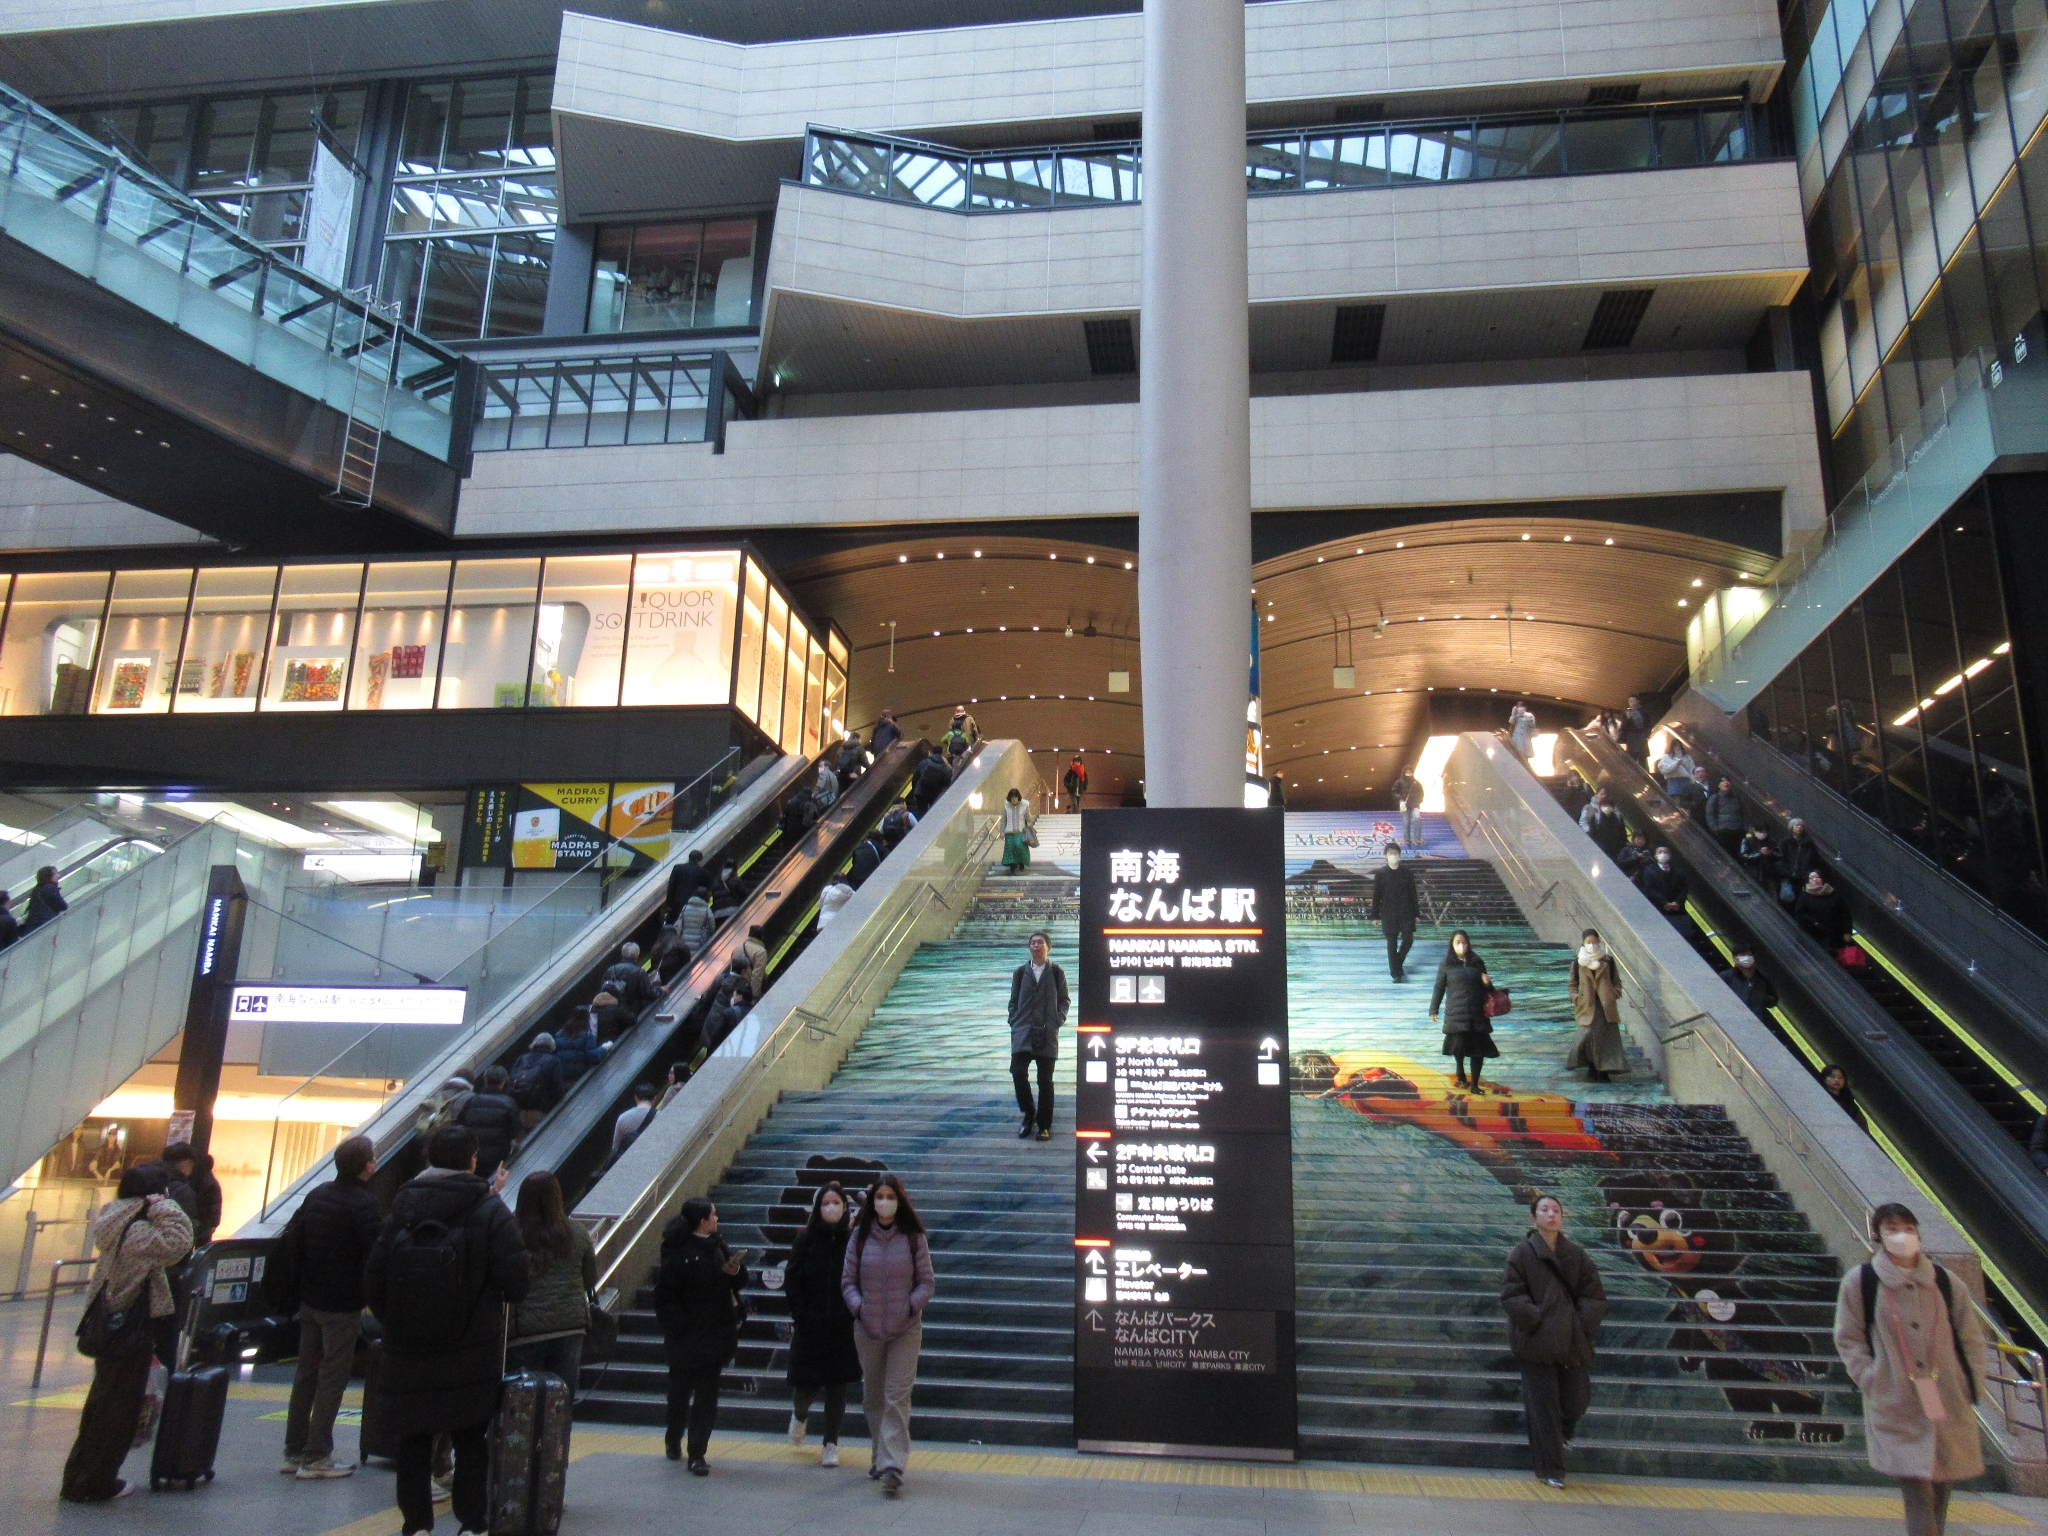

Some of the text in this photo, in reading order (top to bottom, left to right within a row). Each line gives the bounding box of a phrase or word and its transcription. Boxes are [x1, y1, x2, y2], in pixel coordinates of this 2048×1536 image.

[557, 787, 606, 796] MADRAS
[561, 796, 601, 805] CURRY
[551, 841, 600, 849] MADRAS
[557, 850, 592, 858] STAND
[1109, 848, 1180, 884] 南海
[1108, 887, 1257, 923] なんば駅
[202, 898, 222, 975] NANKAI NAMBA
[1109, 939, 1260, 953] NANKAI NAMBA STN.
[1115, 1057, 1179, 1067] 3F North Gate
[1115, 1143, 1215, 1163] 2F中央改札口
[1116, 1164, 1187, 1175] 2F Central Gate
[1116, 1213, 1179, 1222] Commuter Passes
[1114, 1261, 1208, 1280] エレベーター
[1115, 1278, 1155, 1290] Elevator
[1115, 1309, 1216, 1328] なんばパークス
[1115, 1327, 1200, 1345] なんばCITY
[1114, 1347, 1250, 1360] NAMBA PARKS NAMBA CITY
